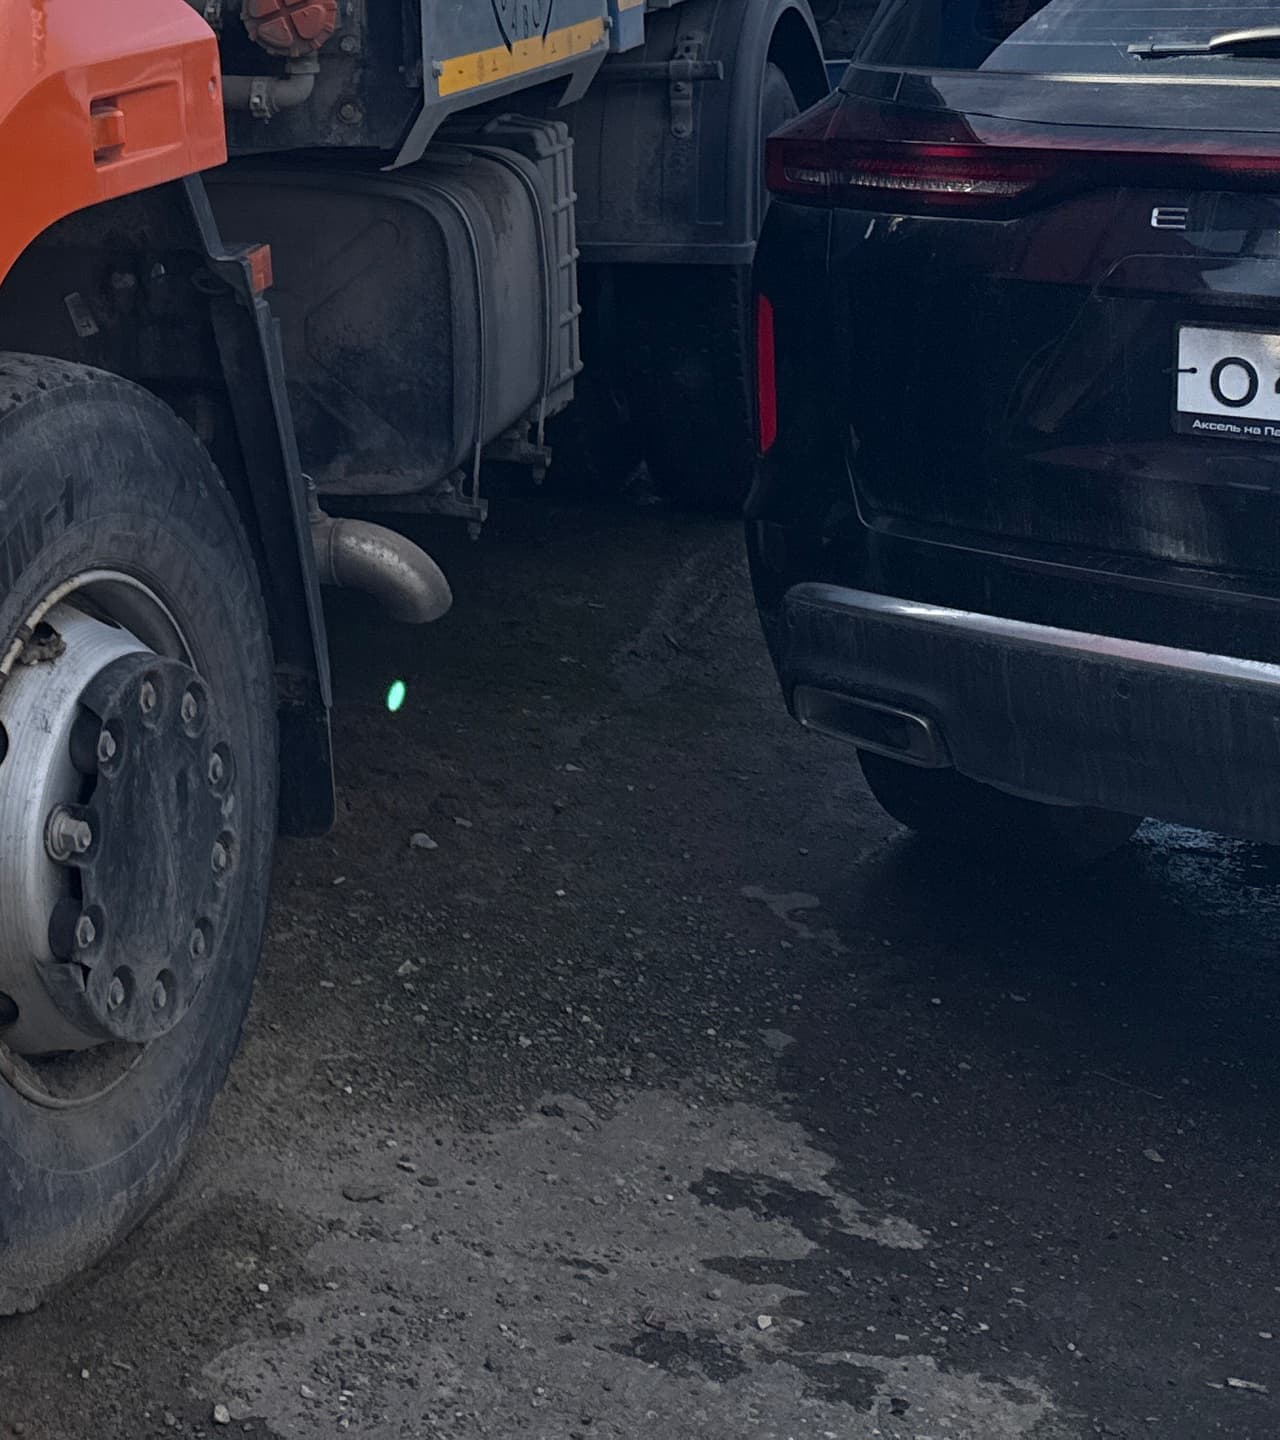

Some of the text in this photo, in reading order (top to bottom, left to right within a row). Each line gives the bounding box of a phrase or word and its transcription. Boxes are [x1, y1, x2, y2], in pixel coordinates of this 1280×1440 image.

[1151, 207, 1189, 229] E
[1192, 419, 1241, 433] Аксель
[1244, 426, 1261, 435] на
